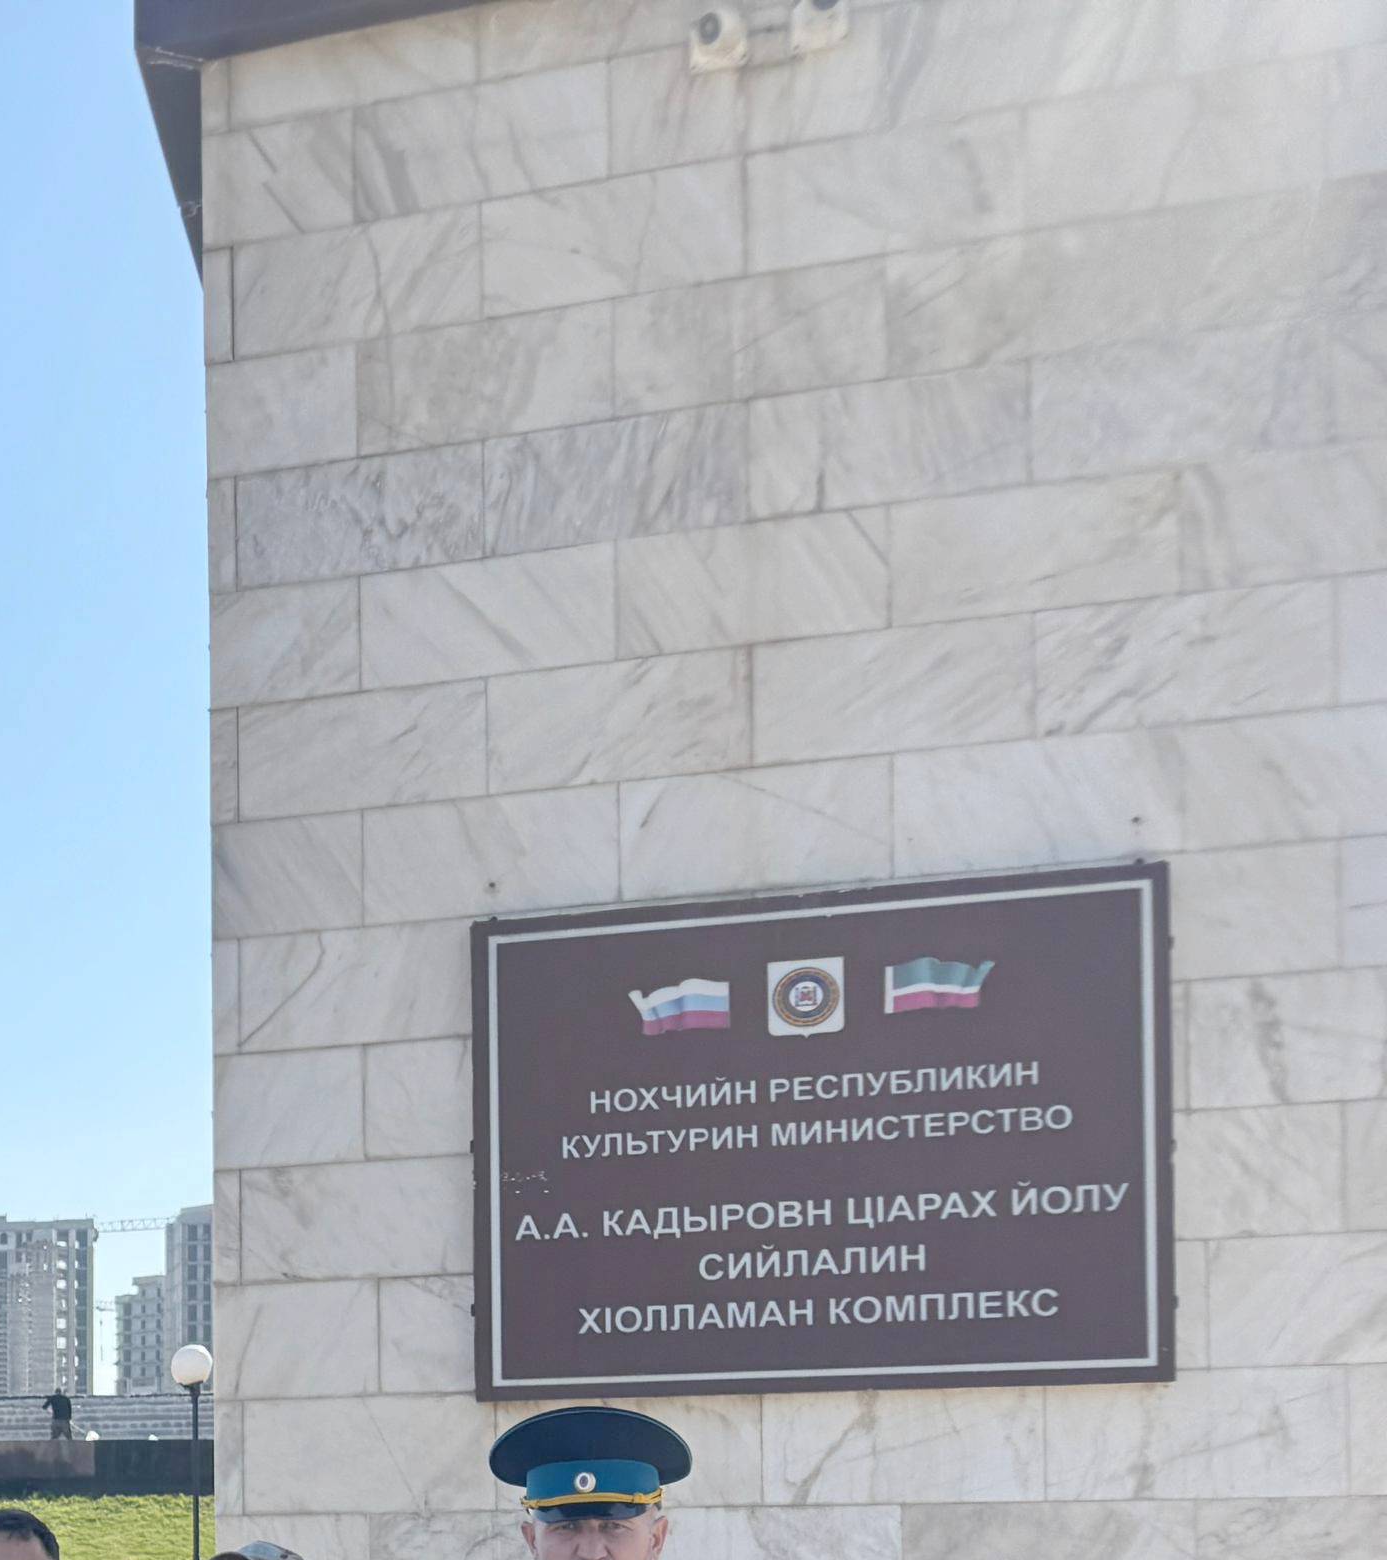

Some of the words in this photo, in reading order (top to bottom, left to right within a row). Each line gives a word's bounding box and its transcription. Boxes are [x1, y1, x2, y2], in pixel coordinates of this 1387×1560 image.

[590, 1076, 757, 1114] НОХЧИЙН
[769, 1060, 1039, 1103] РЕСПУБЛИКИН
[562, 1124, 758, 1159] КУЛЬТУРИН
[771, 1104, 1073, 1147] МИНИСТЕРСТВО
[515, 1212, 589, 1241] А.А.
[603, 1198, 832, 1240] КАДЫРОВН
[1011, 1181, 1129, 1216] ЙОЛУ
[698, 1243, 926, 1281] СИЙЛАЛИН
[829, 1288, 1059, 1325] КОМПЛЕКС
